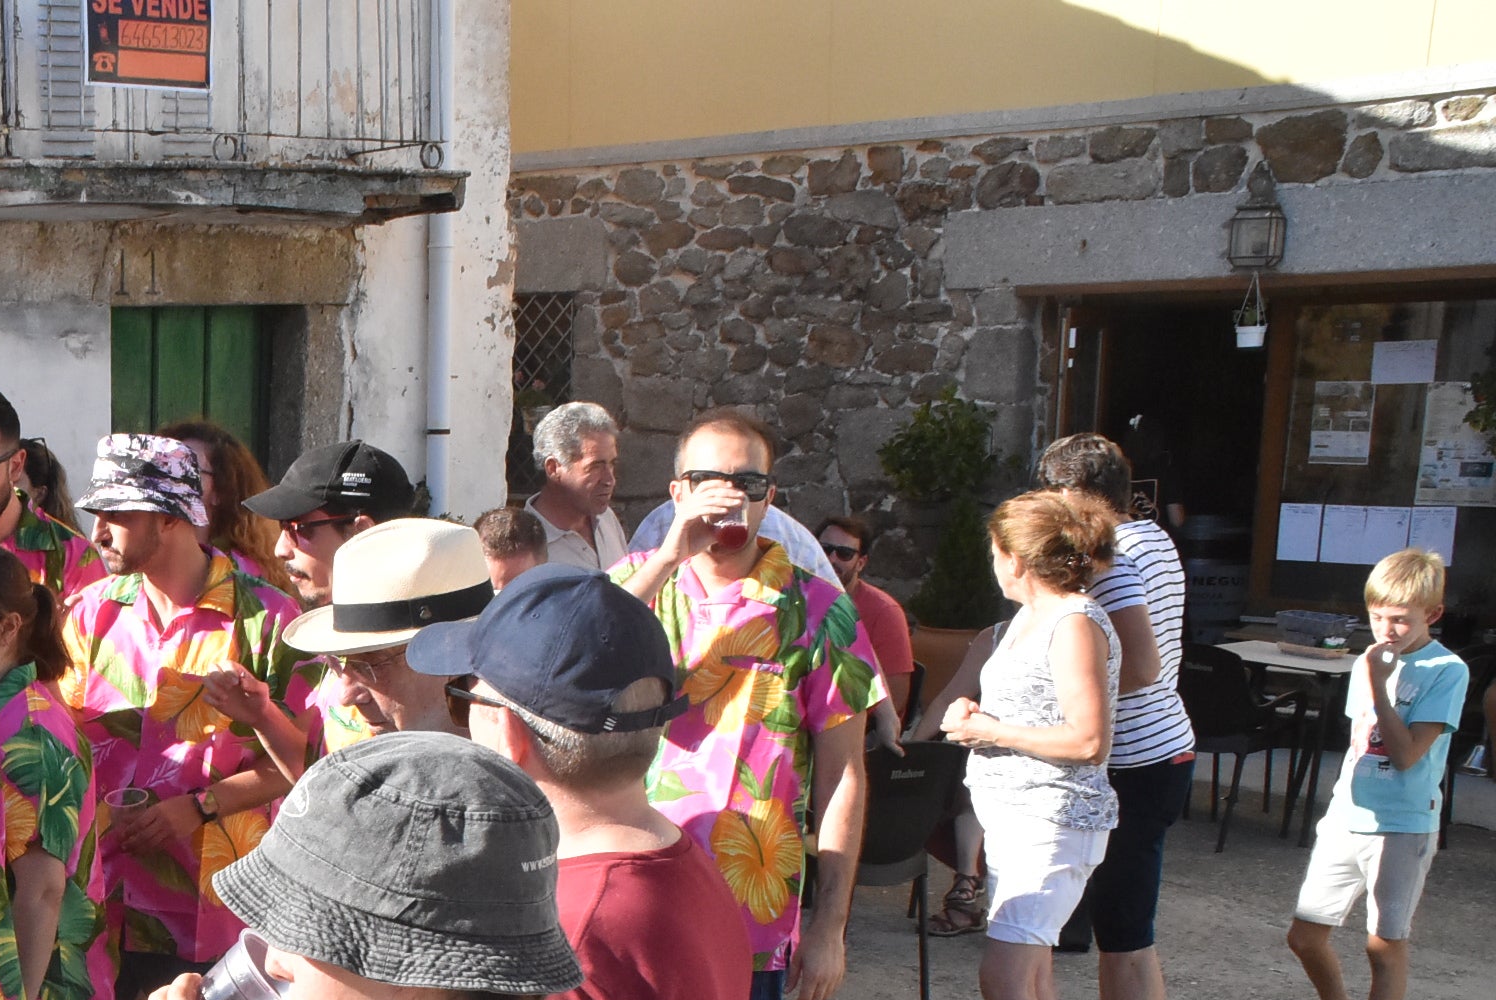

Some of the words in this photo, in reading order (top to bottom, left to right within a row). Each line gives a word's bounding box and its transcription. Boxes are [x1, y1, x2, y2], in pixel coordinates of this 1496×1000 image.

[92, 0, 123, 15] SE
[131, 0, 208, 20] VENDE
[114, 245, 161, 296] 11
